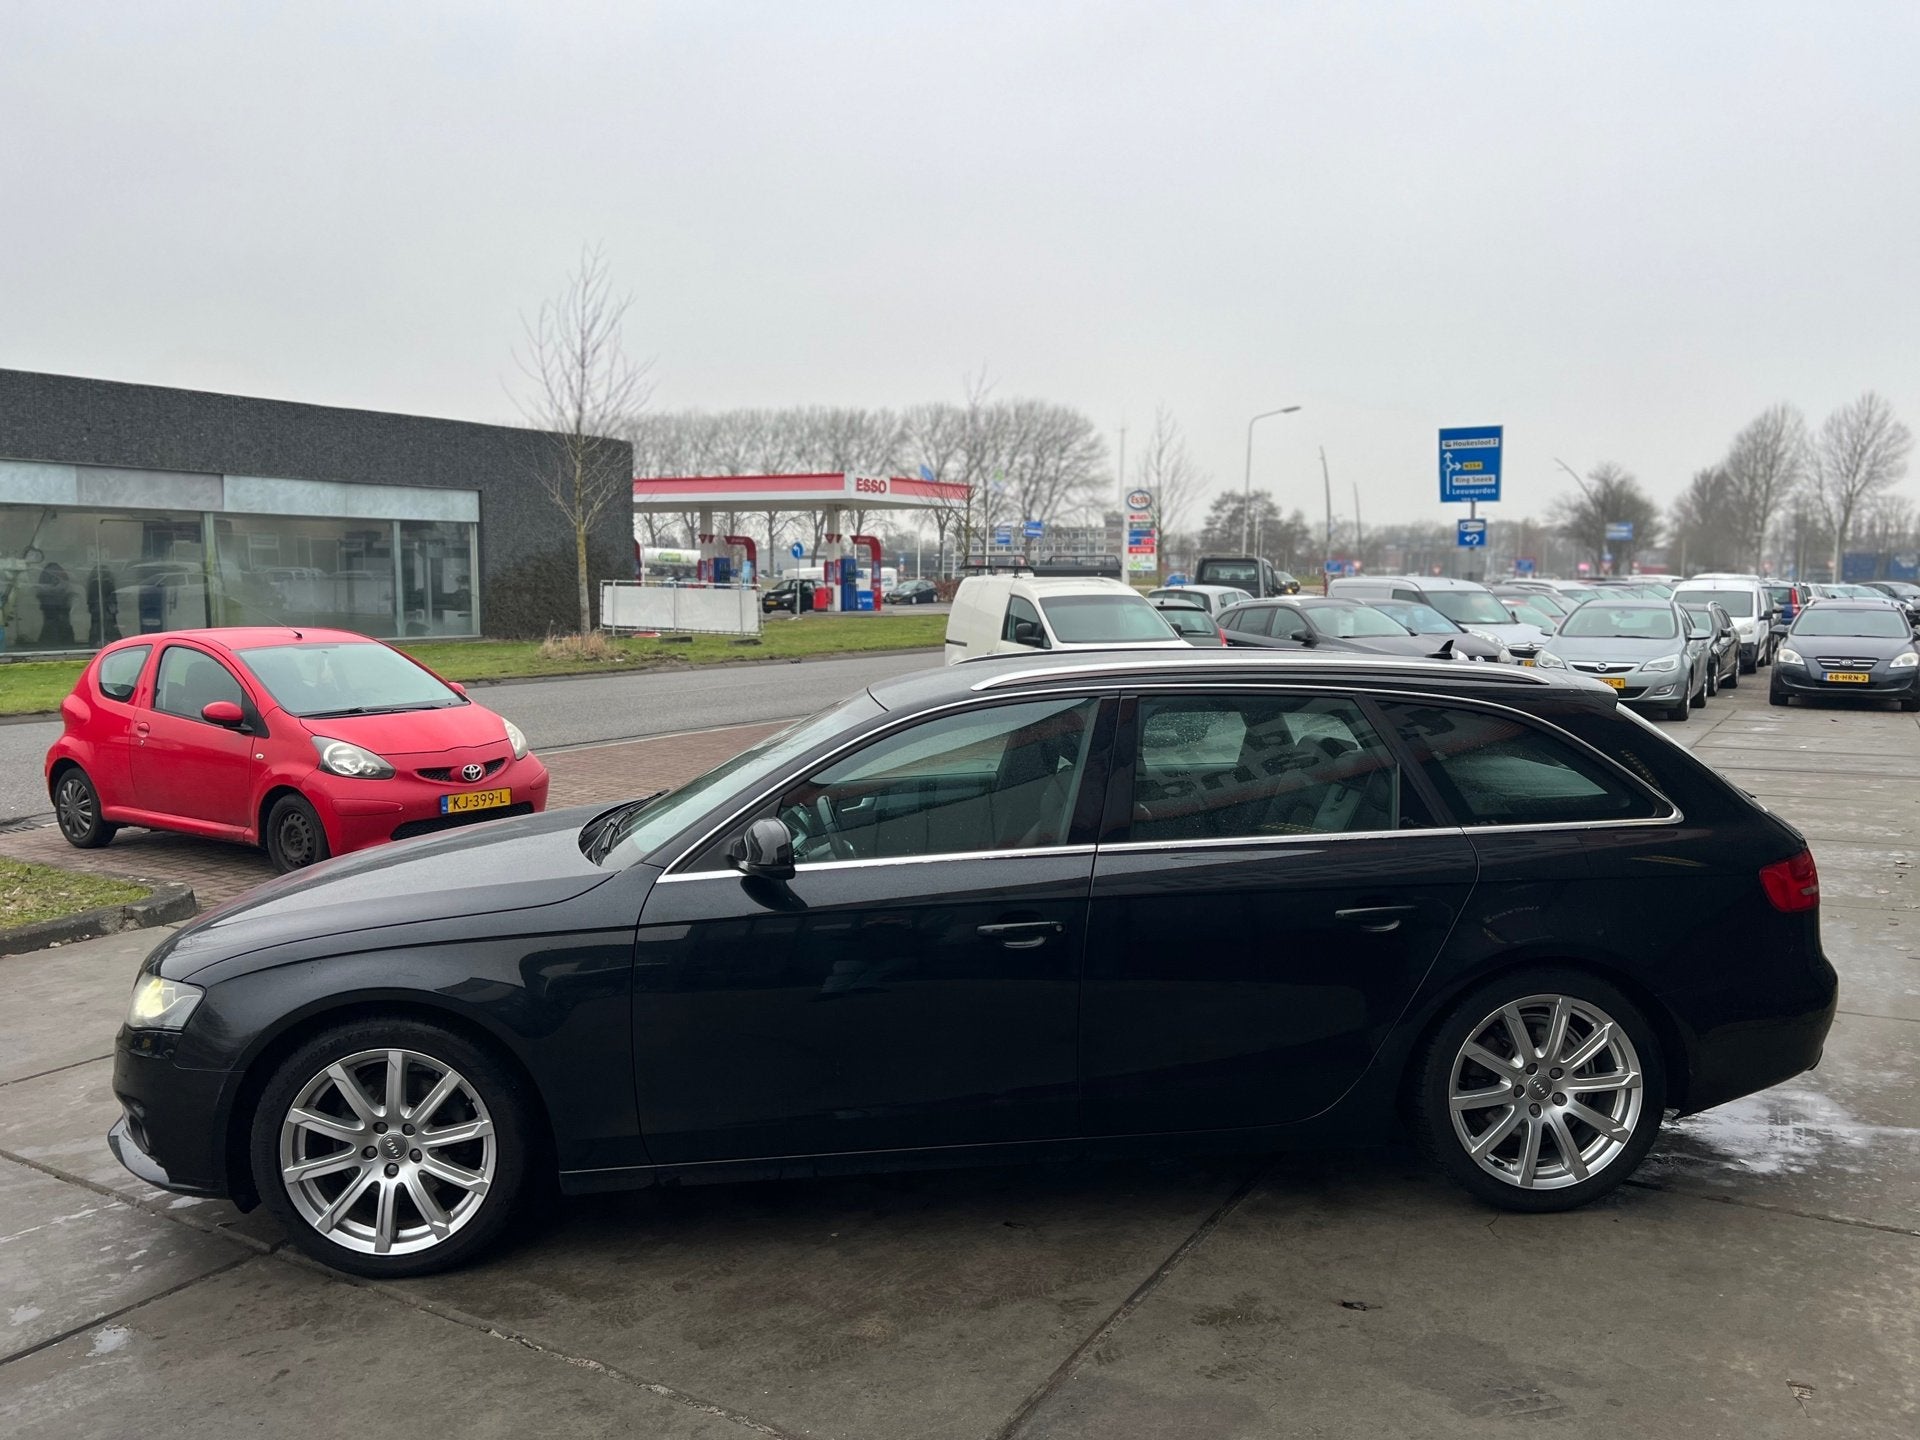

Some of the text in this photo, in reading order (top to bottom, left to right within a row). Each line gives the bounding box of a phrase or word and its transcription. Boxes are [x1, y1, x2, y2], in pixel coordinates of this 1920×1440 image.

[856, 477, 886, 493] ESSO
[1452, 487, 1496, 495] Leeuwarden
[1130, 496, 1148, 504] Esso
[453, 792, 506, 809] KJ-399-L
